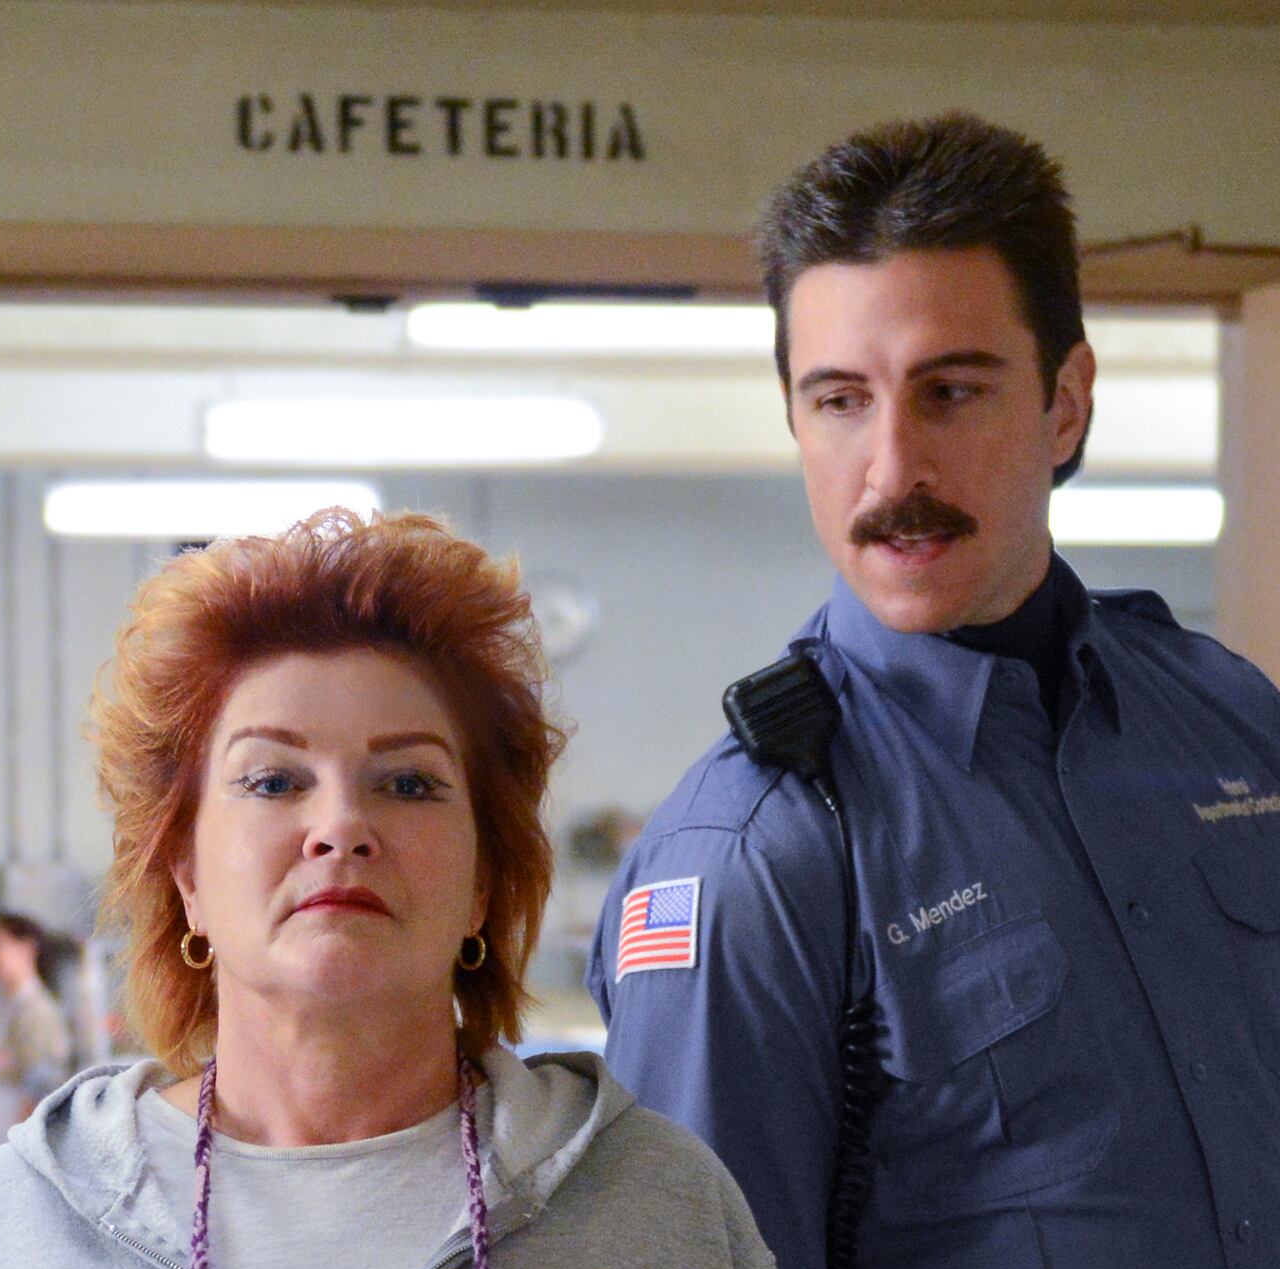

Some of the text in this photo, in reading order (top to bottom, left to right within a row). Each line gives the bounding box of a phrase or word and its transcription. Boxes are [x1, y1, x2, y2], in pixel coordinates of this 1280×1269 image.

[235, 93, 646, 160] CAFETERIA
[887, 882, 988, 945] G. Mendez
